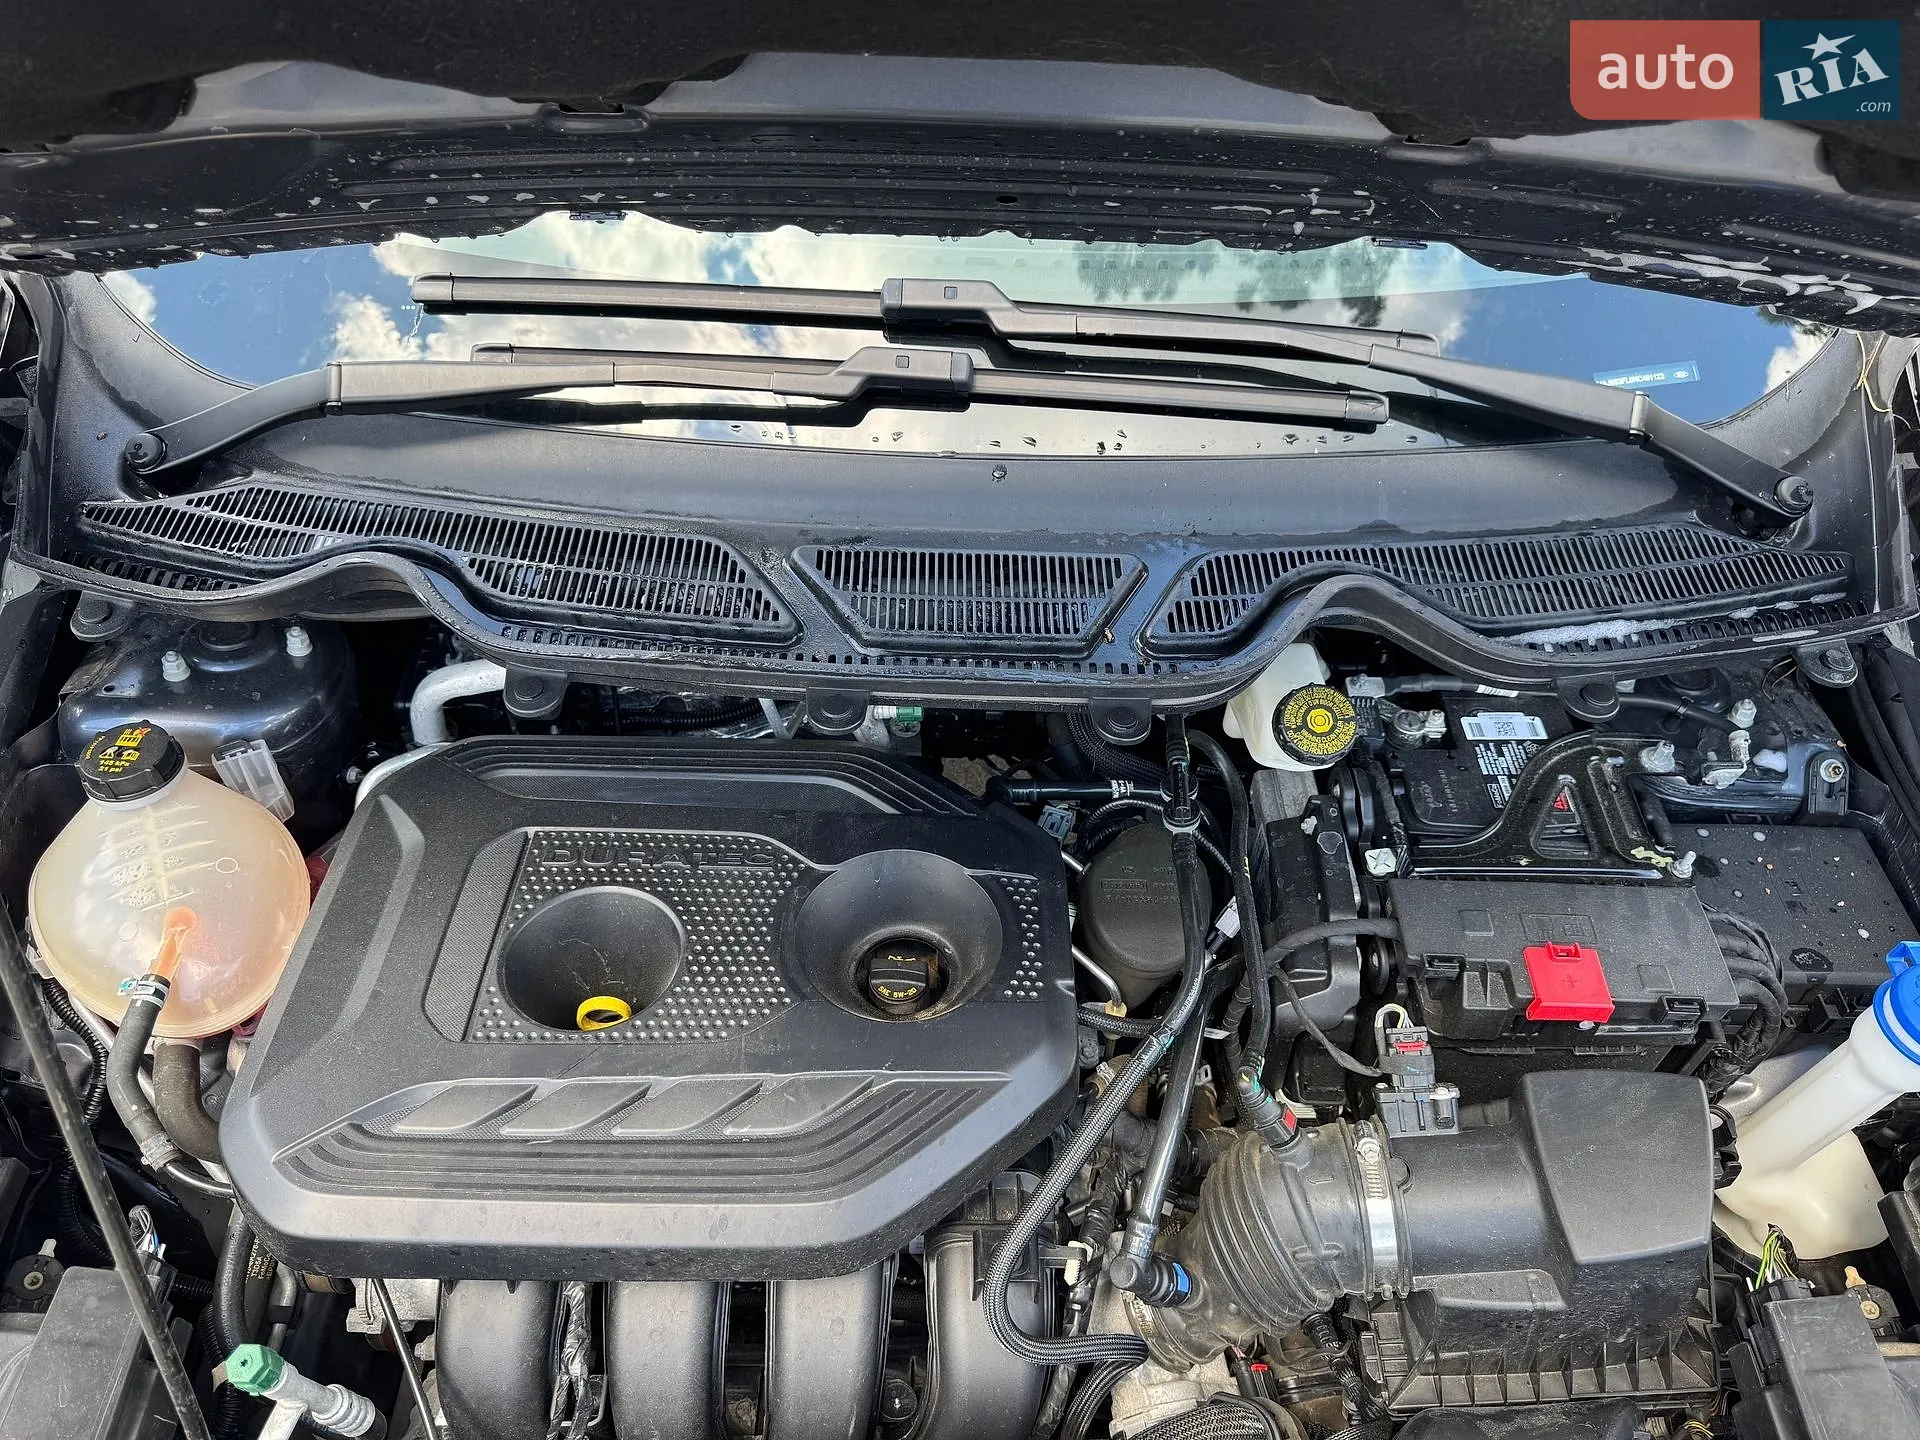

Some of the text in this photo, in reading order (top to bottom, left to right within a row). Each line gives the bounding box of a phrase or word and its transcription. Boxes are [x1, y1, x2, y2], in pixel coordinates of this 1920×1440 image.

[1286, 729, 1296, 740] DOT
[1294, 740, 1309, 752] FLUID
[1321, 731, 1337, 743] CLEAN
[541, 849, 775, 869] DURATEC
[878, 985, 918, 999] SAE 5W-20
[258, 1254, 272, 1280] FoMoCo
